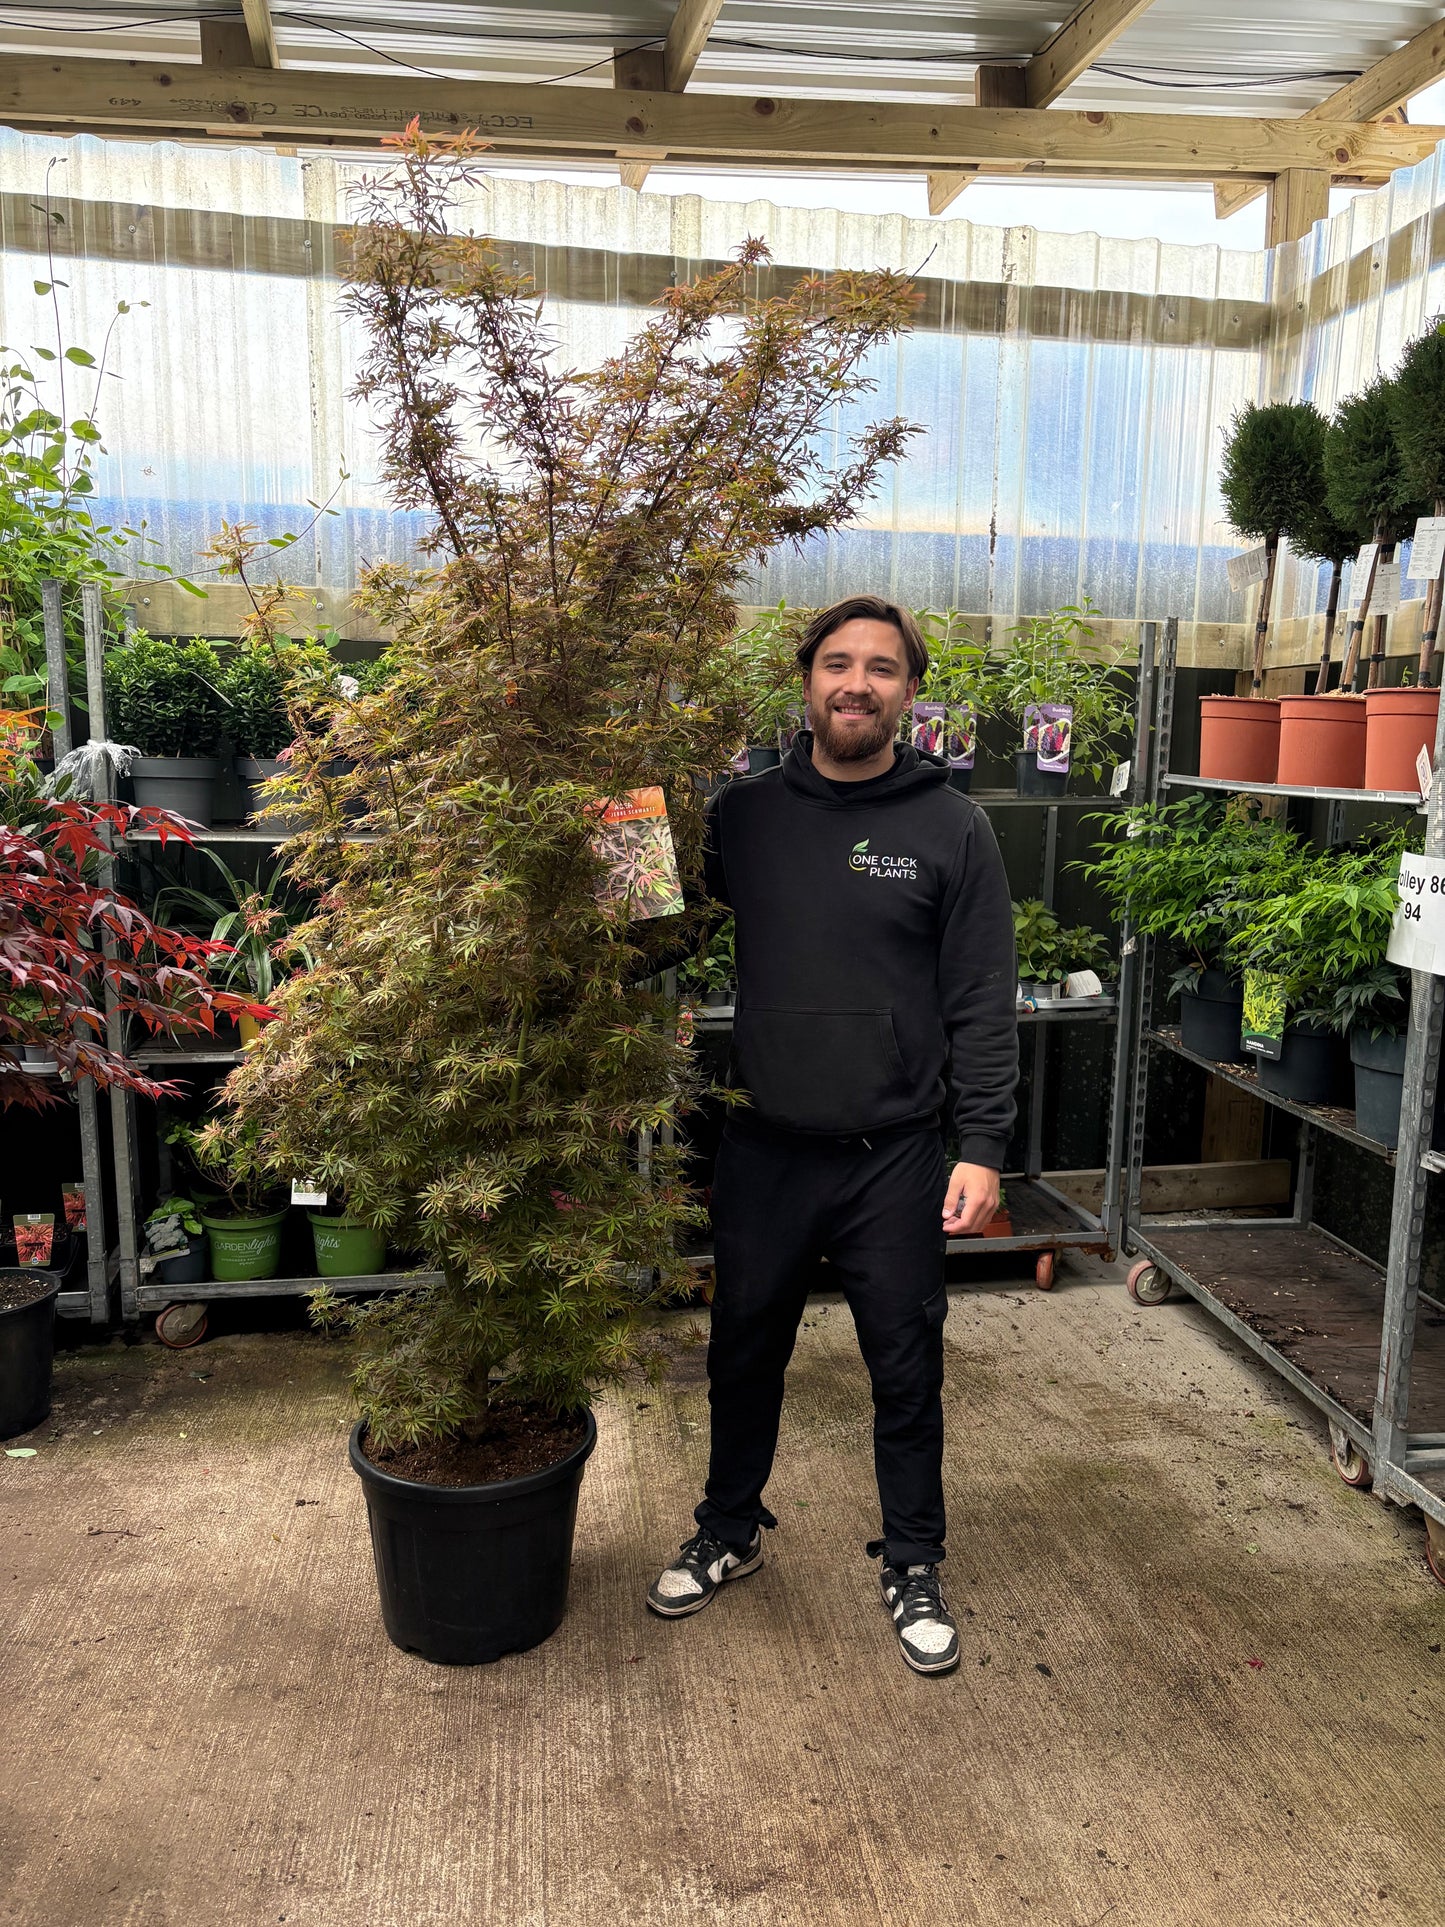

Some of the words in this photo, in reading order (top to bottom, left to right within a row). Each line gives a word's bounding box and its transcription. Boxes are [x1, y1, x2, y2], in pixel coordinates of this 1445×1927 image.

[293, 103, 321, 117] CE
[852, 854, 879, 866] ONE
[881, 856, 918, 868] CLICK
[869, 867, 917, 880] PLANTS
[1398, 869, 1426, 895] olley
[1404, 902, 1422, 922] 94
